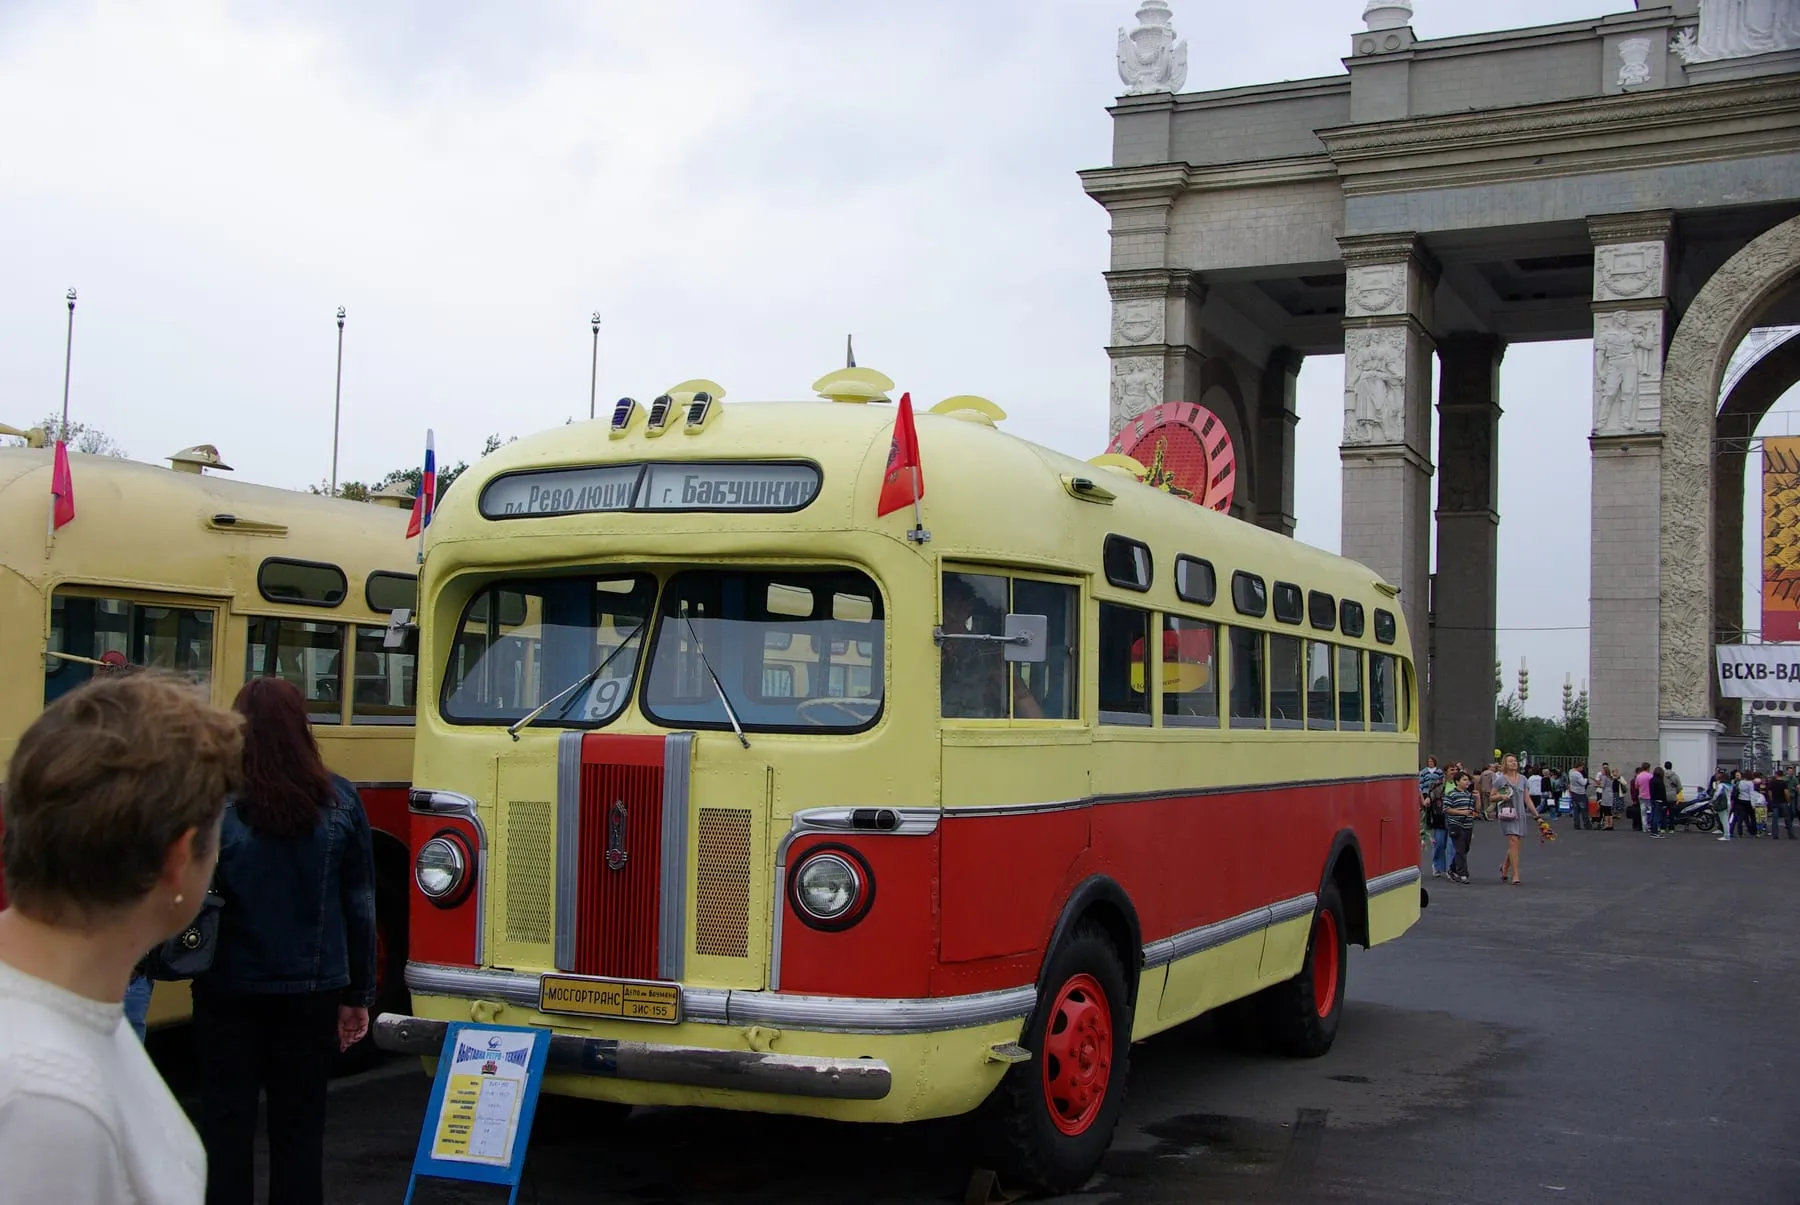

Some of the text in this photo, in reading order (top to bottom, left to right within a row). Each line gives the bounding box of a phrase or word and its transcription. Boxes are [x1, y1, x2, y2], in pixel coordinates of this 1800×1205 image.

[662, 488, 673, 504] г.
[590, 680, 620, 718] 9
[548, 987, 621, 1006] МОСГОРТРАНС
[632, 1004, 668, 1016] ЗИС-155
